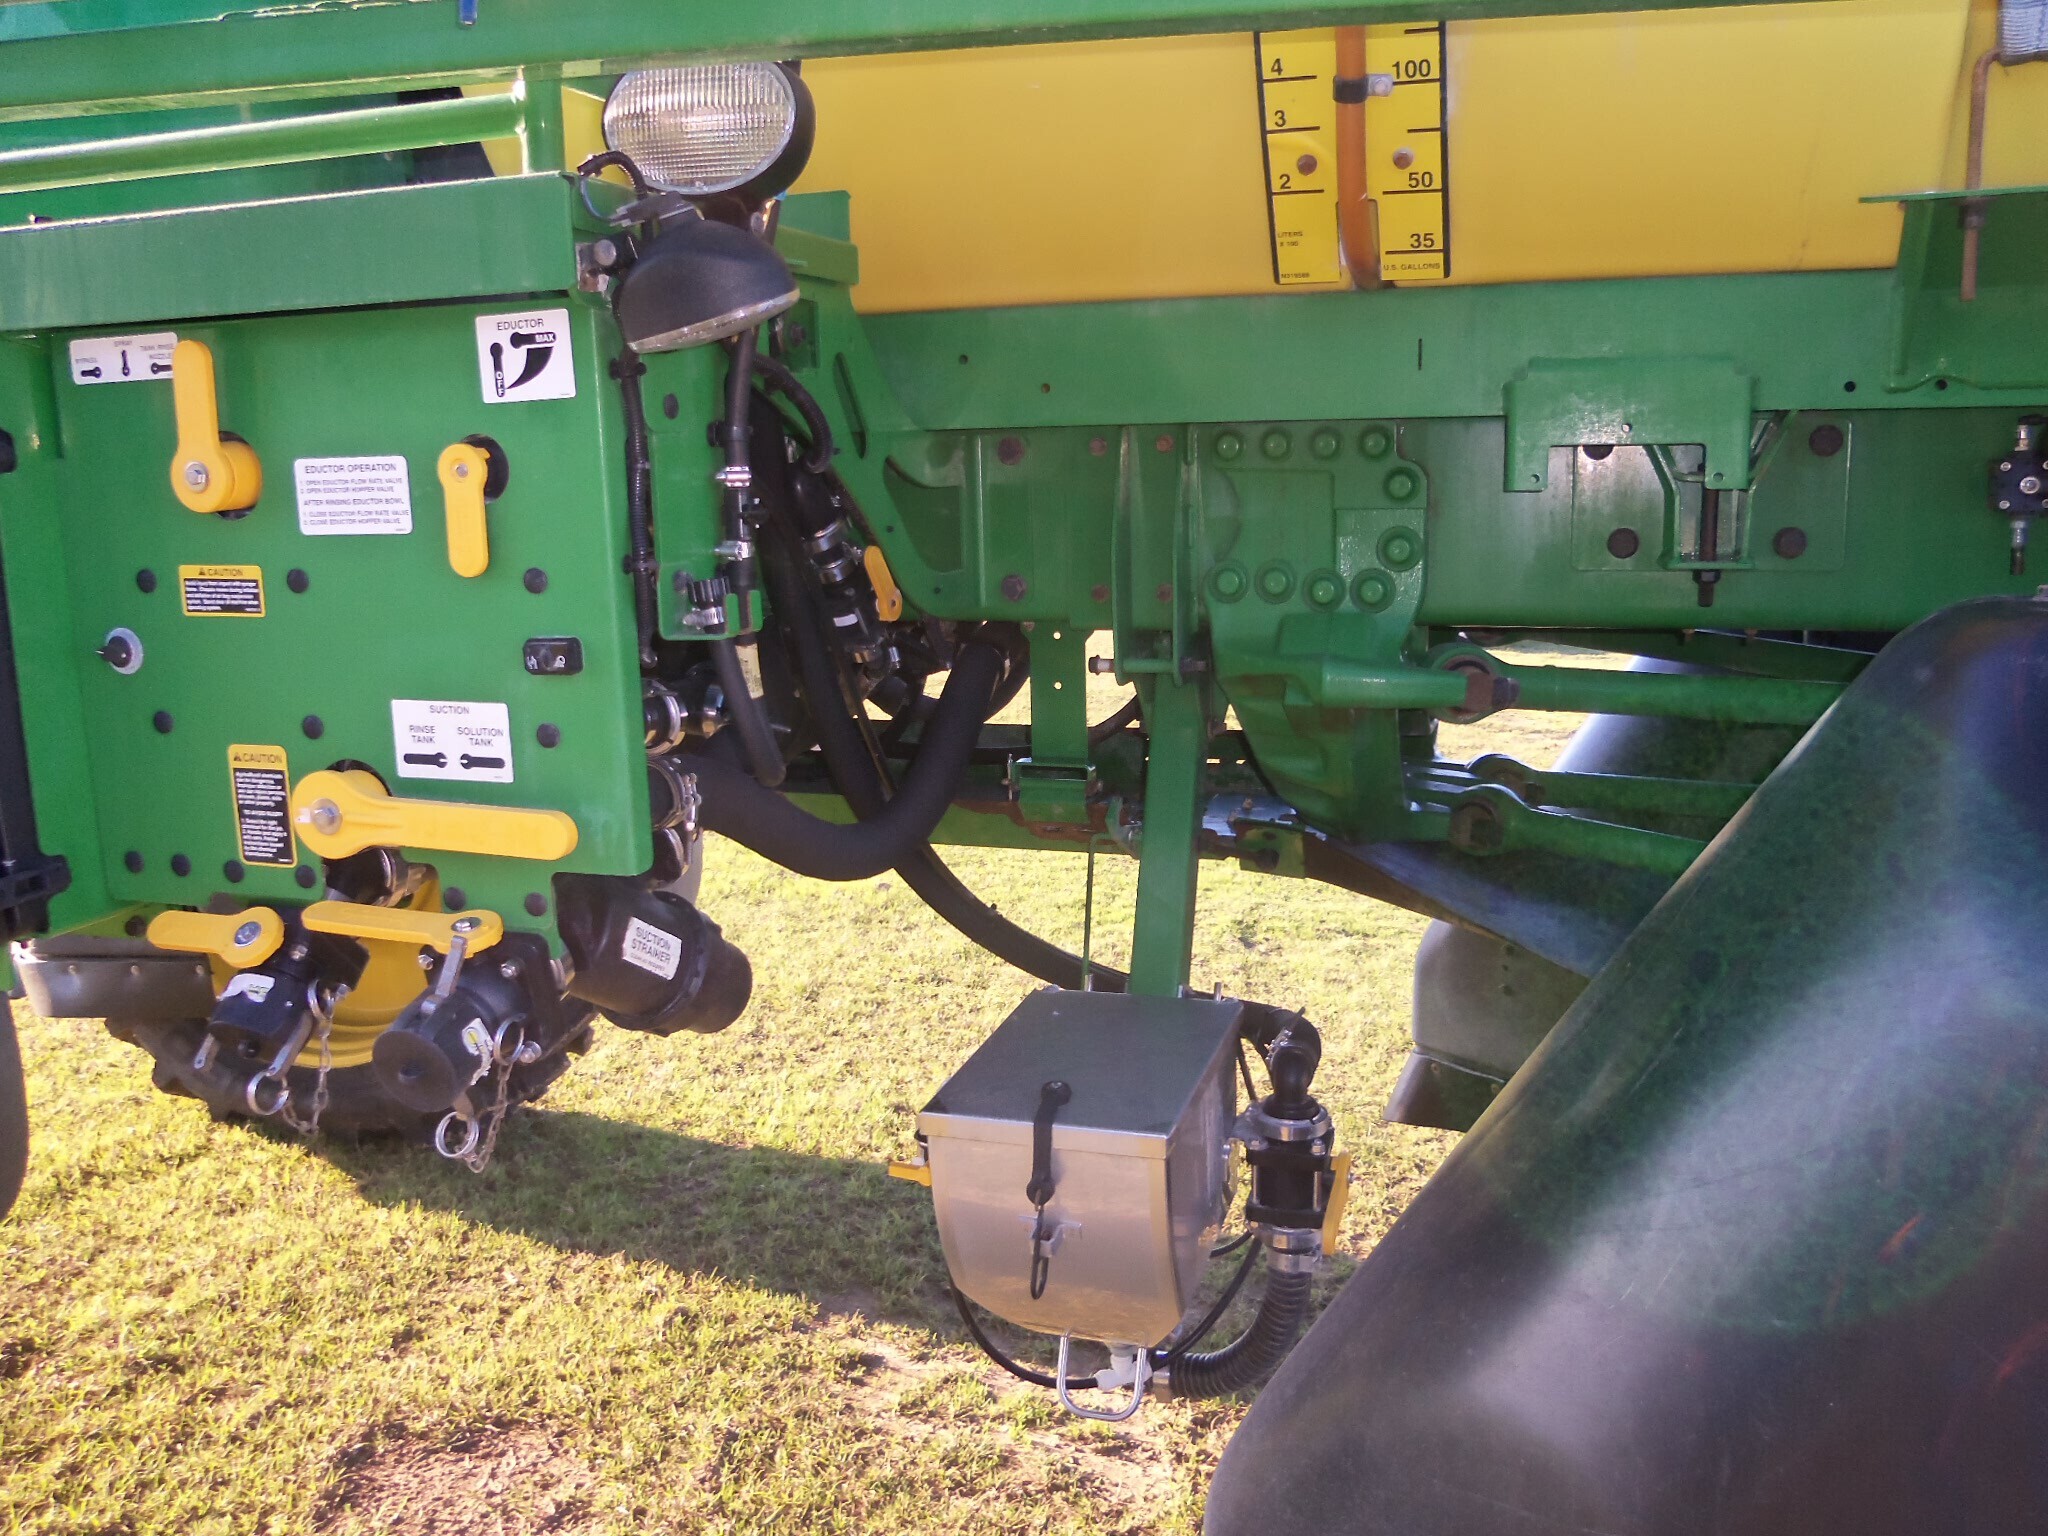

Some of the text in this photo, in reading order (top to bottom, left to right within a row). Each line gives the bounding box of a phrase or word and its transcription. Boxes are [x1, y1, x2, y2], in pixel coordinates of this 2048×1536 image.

[1271, 58, 1283, 75] 4
[1392, 59, 1431, 79] 100
[1274, 110, 1286, 127] 3
[1279, 174, 1291, 190] 2
[1408, 171, 1433, 188] 50
[1410, 233, 1435, 249] 35
[1400, 262, 1440, 270] GALLONS
[497, 318, 544, 331] EDUCTOR
[535, 334, 554, 343] MAX
[496, 371, 505, 396] OFF
[304, 463, 397, 474] EDUCTOR OPERATION
[208, 568, 243, 576] CAUTION
[429, 704, 470, 714] SUCTION
[409, 725, 436, 734] RINSE
[457, 726, 504, 737] SOLUTION
[411, 735, 436, 744] TANK
[469, 737, 494, 747] TANK
[243, 752, 283, 764] CAUTION
[636, 926, 671, 951] SUCTION
[631, 938, 671, 965] STRAINER
